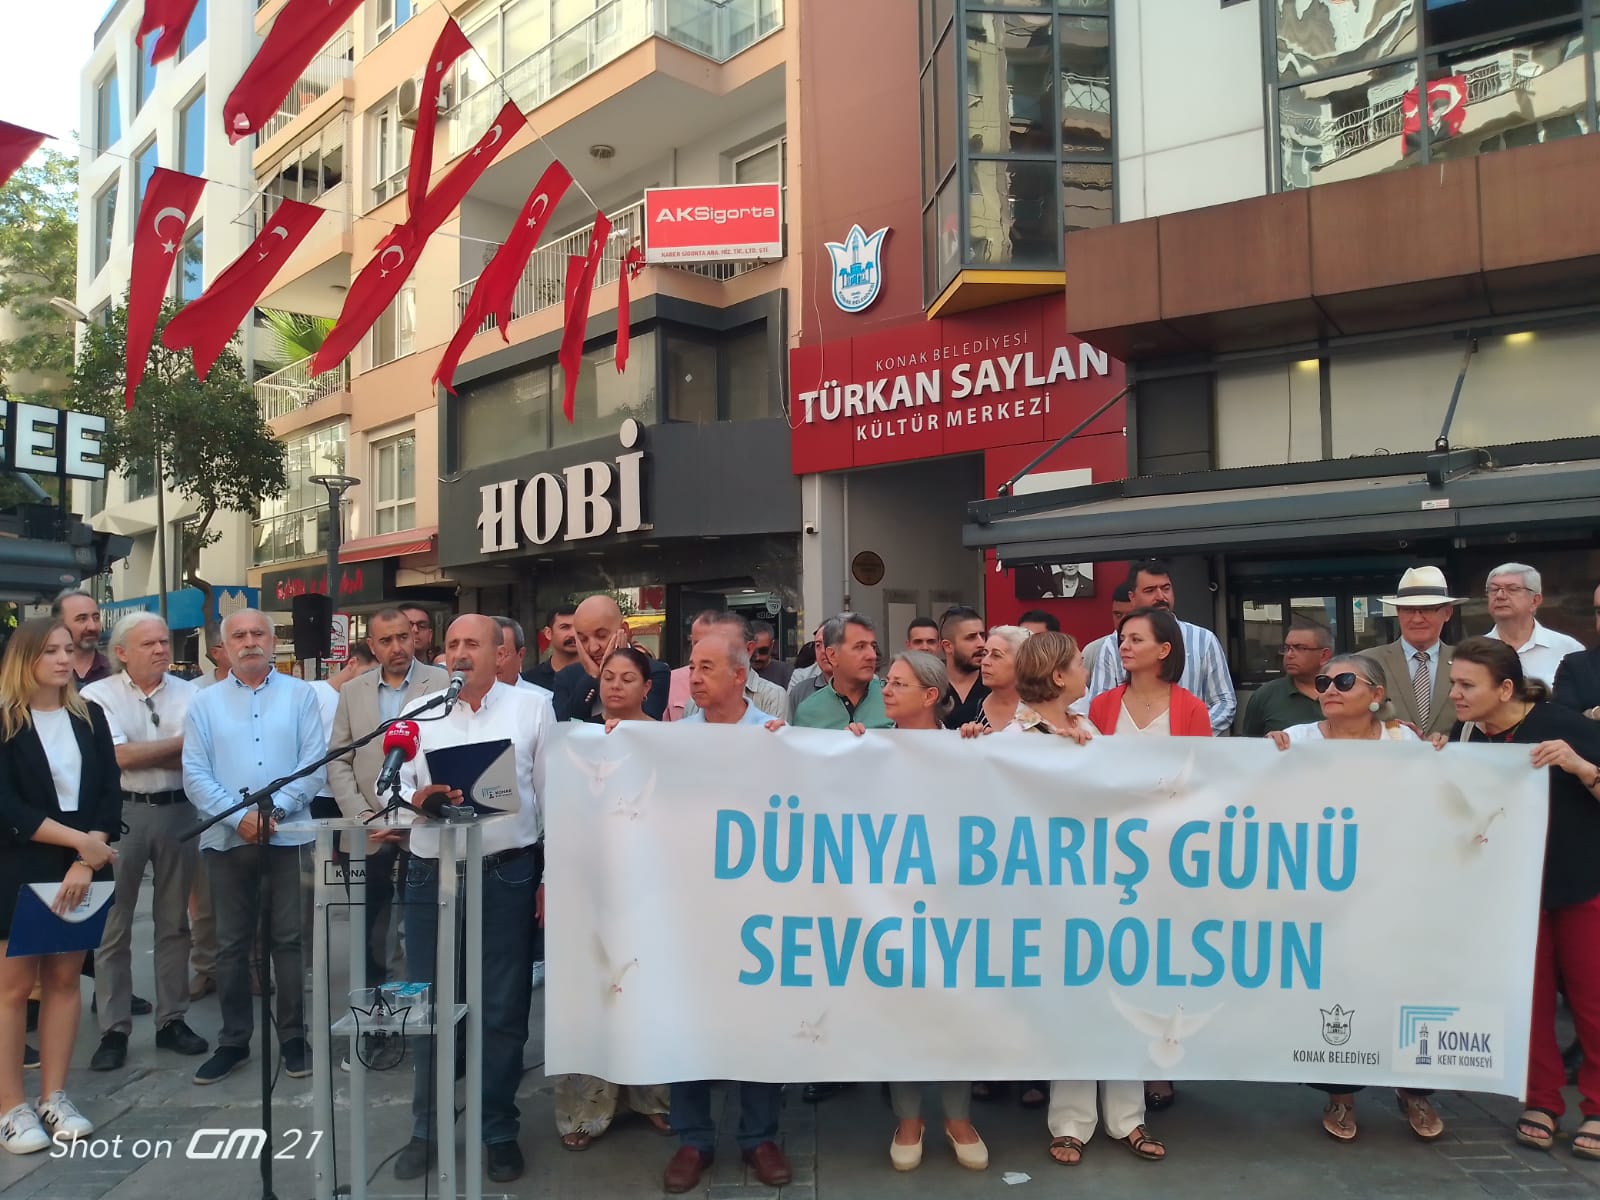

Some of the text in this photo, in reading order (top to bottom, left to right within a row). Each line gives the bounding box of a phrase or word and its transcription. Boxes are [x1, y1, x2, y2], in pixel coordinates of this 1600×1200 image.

[655, 206, 776, 224] AKSigorta
[876, 329, 1029, 372] KONAK BELEDİYESİ
[798, 342, 1109, 424] TÜRKAN SAYLAN
[856, 392, 1051, 441] KÜLTÜR MERKEZİ
[477, 418, 654, 554] HOBİ
[714, 794, 1358, 905] DÜNYA BARIŞ GÜNÜ
[738, 900, 1323, 990] SEVGİYLE DOLSUN
[1293, 1049, 1380, 1065] KONAK BELEDİYESİ
[1437, 1054, 1493, 1069] KENT KONSEYİ
[1438, 1030, 1492, 1053] KONAK
